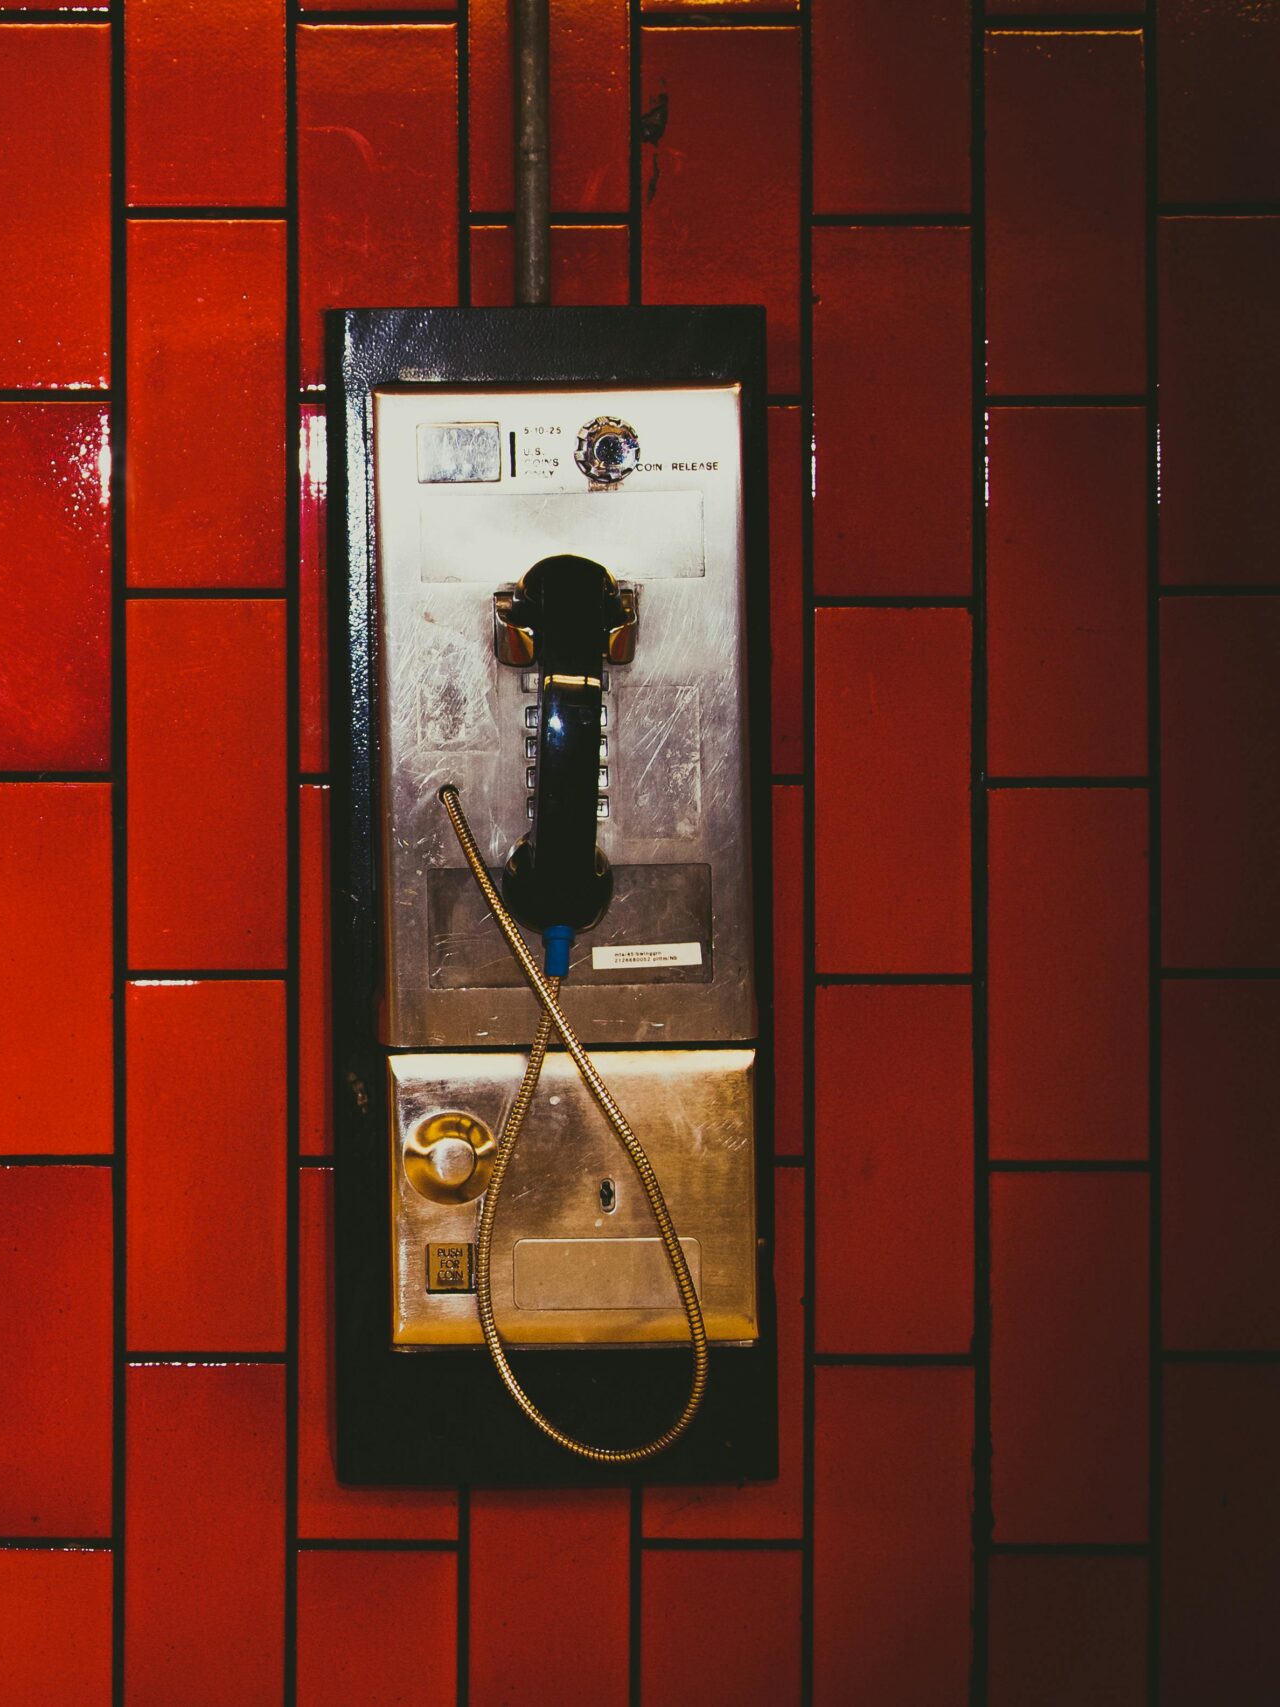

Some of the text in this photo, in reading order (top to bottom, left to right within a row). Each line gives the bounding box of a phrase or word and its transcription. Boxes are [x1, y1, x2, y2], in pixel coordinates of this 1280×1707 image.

[636, 462, 719, 472] COIN RELEASE
[524, 470, 555, 479] LY
[437, 1248, 463, 1257] PUSH
[440, 1259, 460, 1269] FOR
[437, 1270, 464, 1280] COIN
